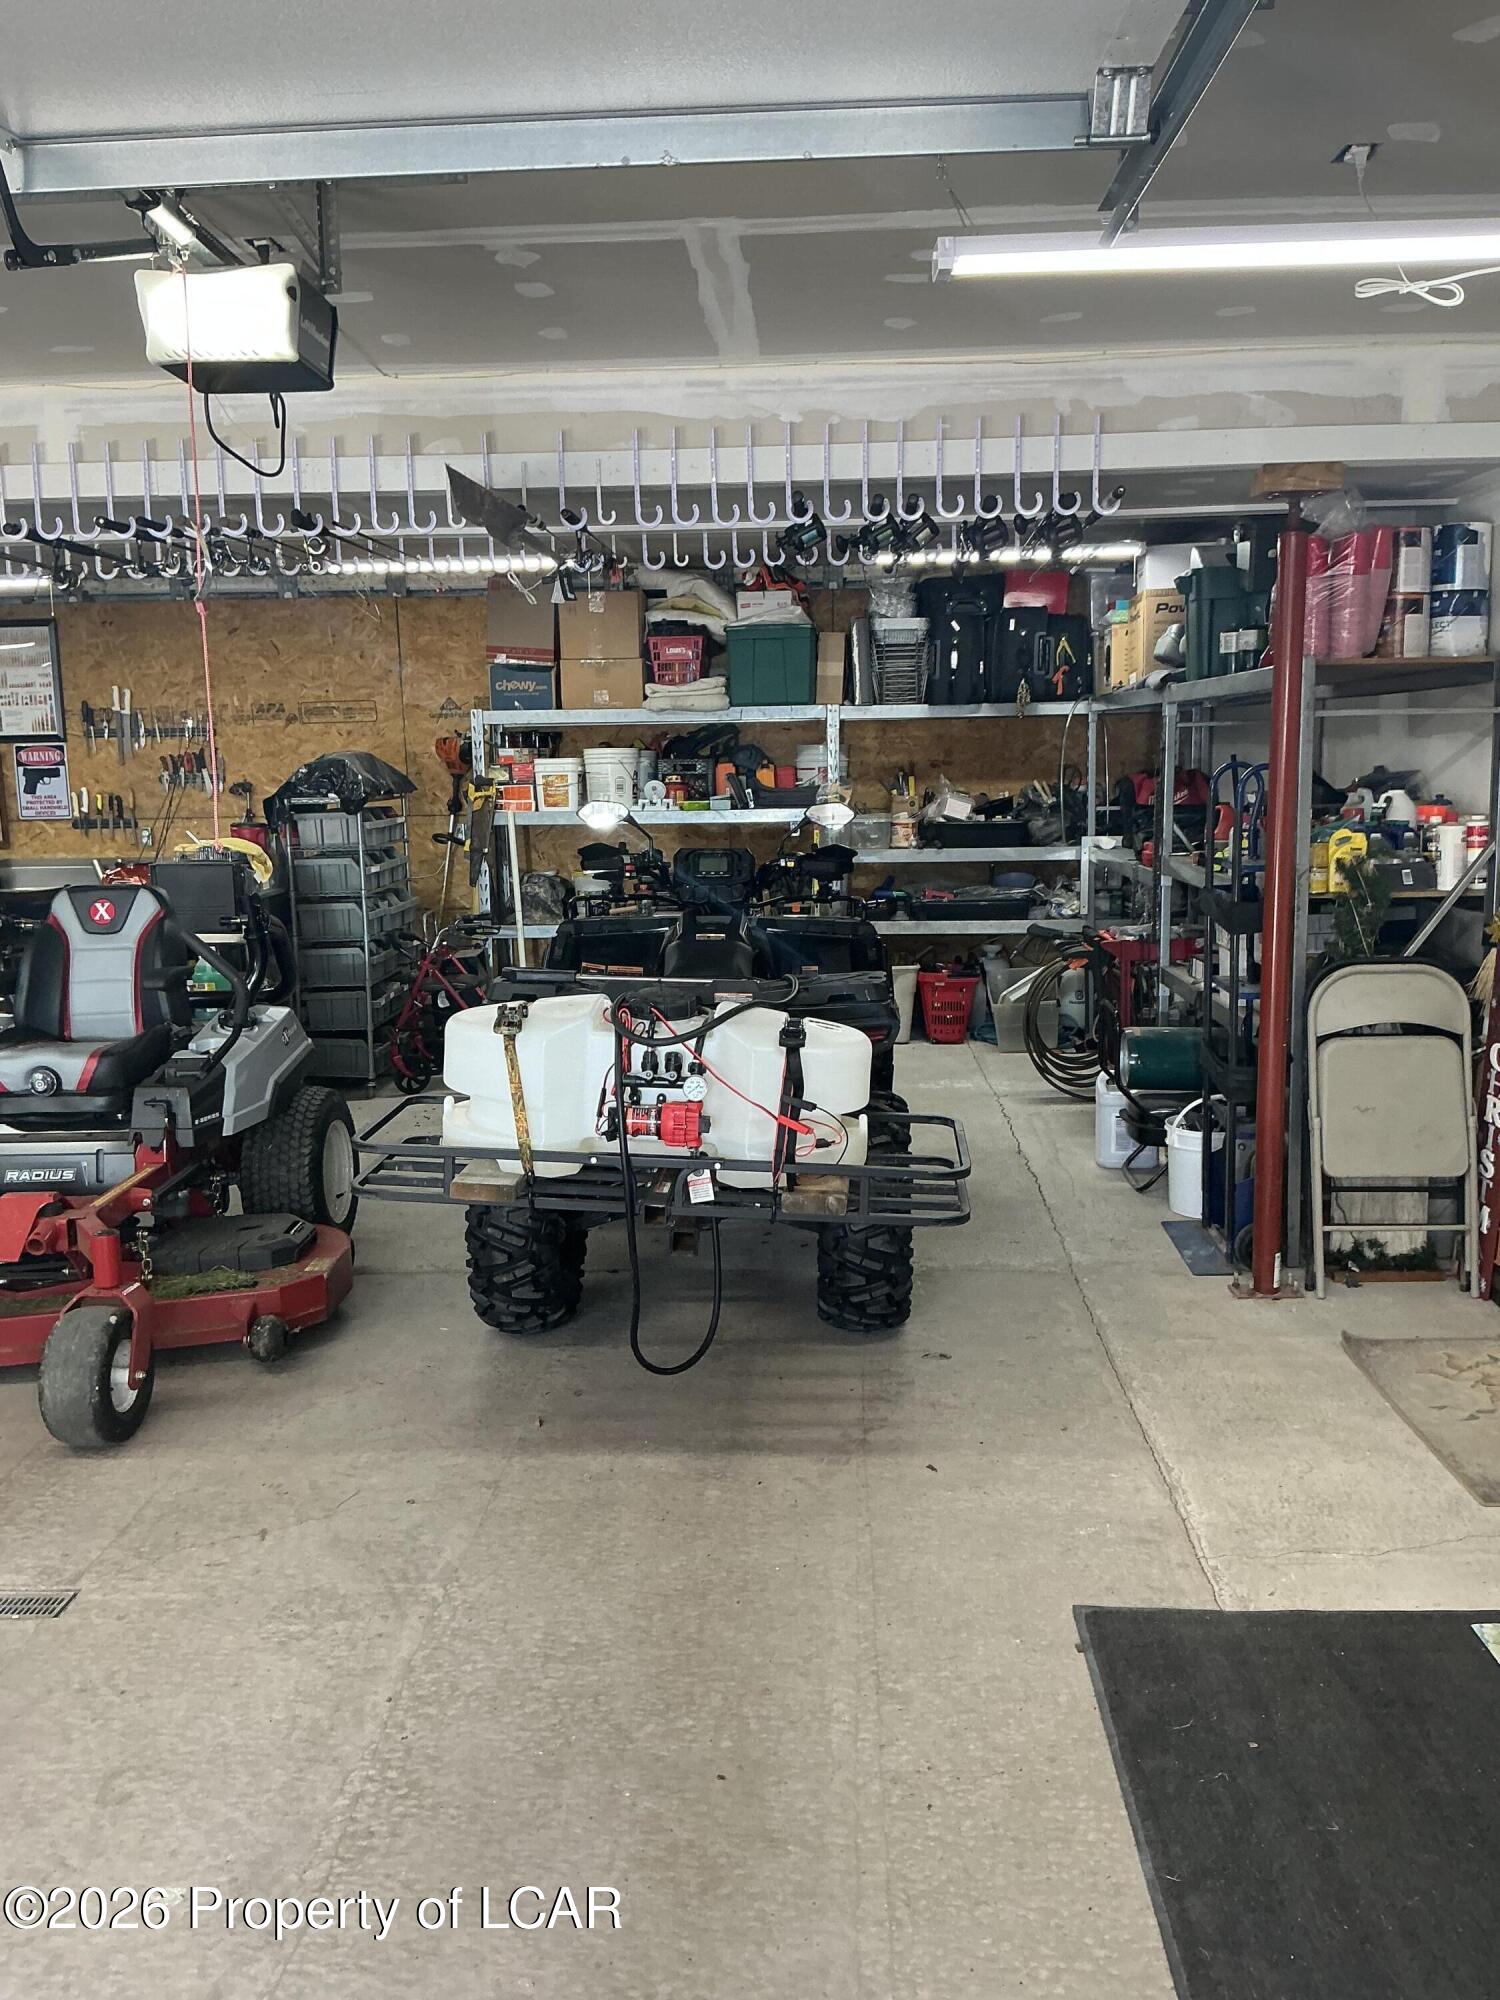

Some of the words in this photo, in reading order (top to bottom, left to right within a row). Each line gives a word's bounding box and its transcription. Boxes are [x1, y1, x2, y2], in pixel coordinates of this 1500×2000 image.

[20, 750, 61, 762] WARNING
[94, 902, 112, 920] X
[5, 1169, 76, 1182] RADIUS
